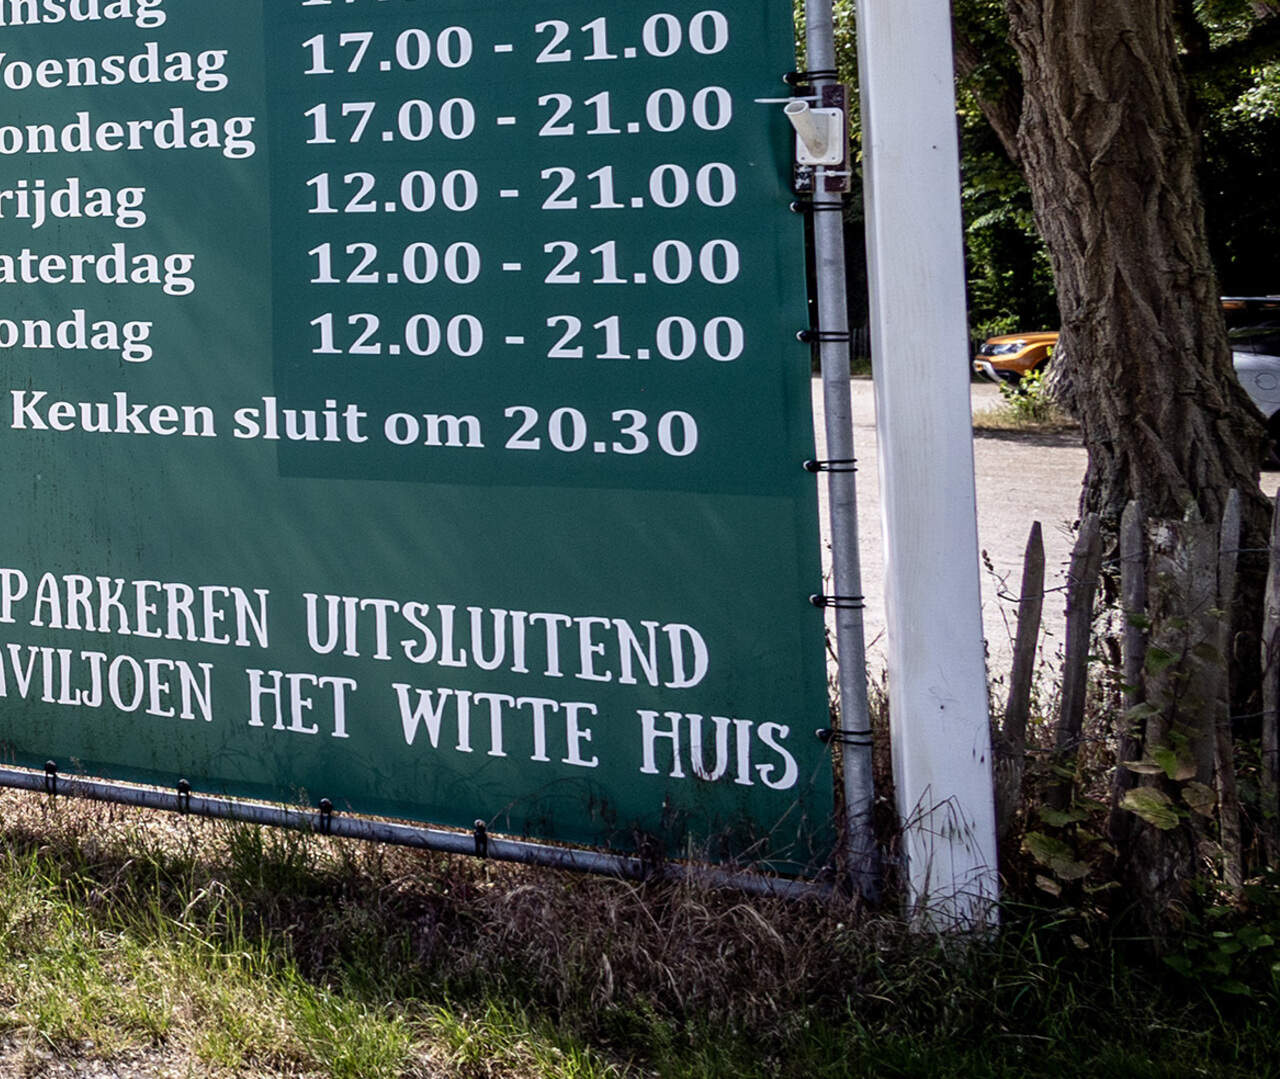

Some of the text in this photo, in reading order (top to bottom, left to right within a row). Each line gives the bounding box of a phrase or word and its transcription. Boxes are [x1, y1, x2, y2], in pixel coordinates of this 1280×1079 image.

[301, 26, 473, 75] 17.00
[535, 10, 729, 64] 21.00
[303, 97, 475, 144] 17.00
[538, 86, 732, 137] 21.00
[306, 169, 478, 214] 12.00
[540, 162, 736, 210] 21.00
[308, 241, 481, 284] 12.00
[543, 239, 740, 284] 21.00
[310, 312, 483, 357] 12.00
[546, 315, 744, 362] 21.00
[10, 390, 698, 457] Keuken sluit om 20.30
[302, 592, 709, 689] UITSLUITEND
[245, 668, 358, 738] HET
[391, 682, 599, 768] WITTE
[636, 709, 798, 790] HUIS
